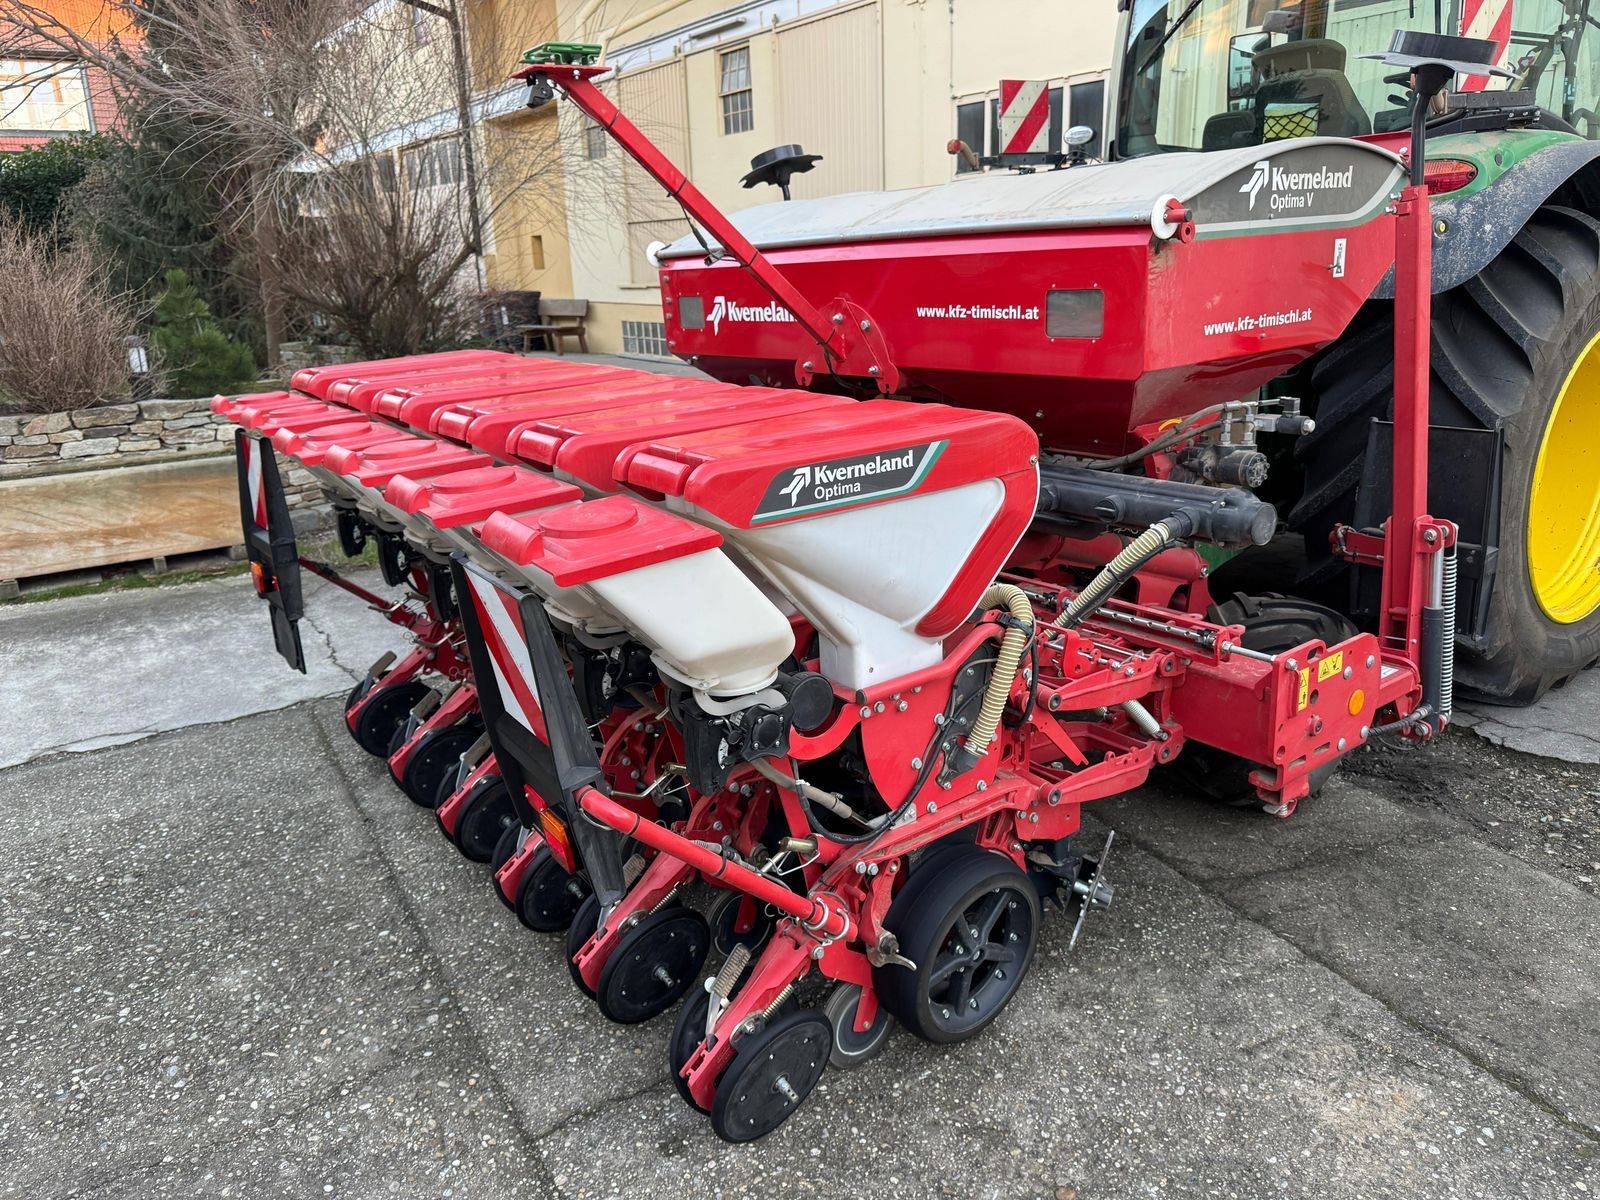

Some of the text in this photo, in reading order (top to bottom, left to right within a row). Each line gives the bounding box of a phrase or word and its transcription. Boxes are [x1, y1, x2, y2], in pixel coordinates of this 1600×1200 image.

[1271, 165, 1353, 191] Kverneland
[1270, 192, 1314, 212] Optima V
[727, 301, 798, 322] Kvernelan
[916, 304, 1039, 320] www.kfz-timischl.at
[1204, 307, 1313, 336] www.kfz-timischl.at
[814, 449, 914, 485] Kverneland
[814, 482, 861, 501] Optima
